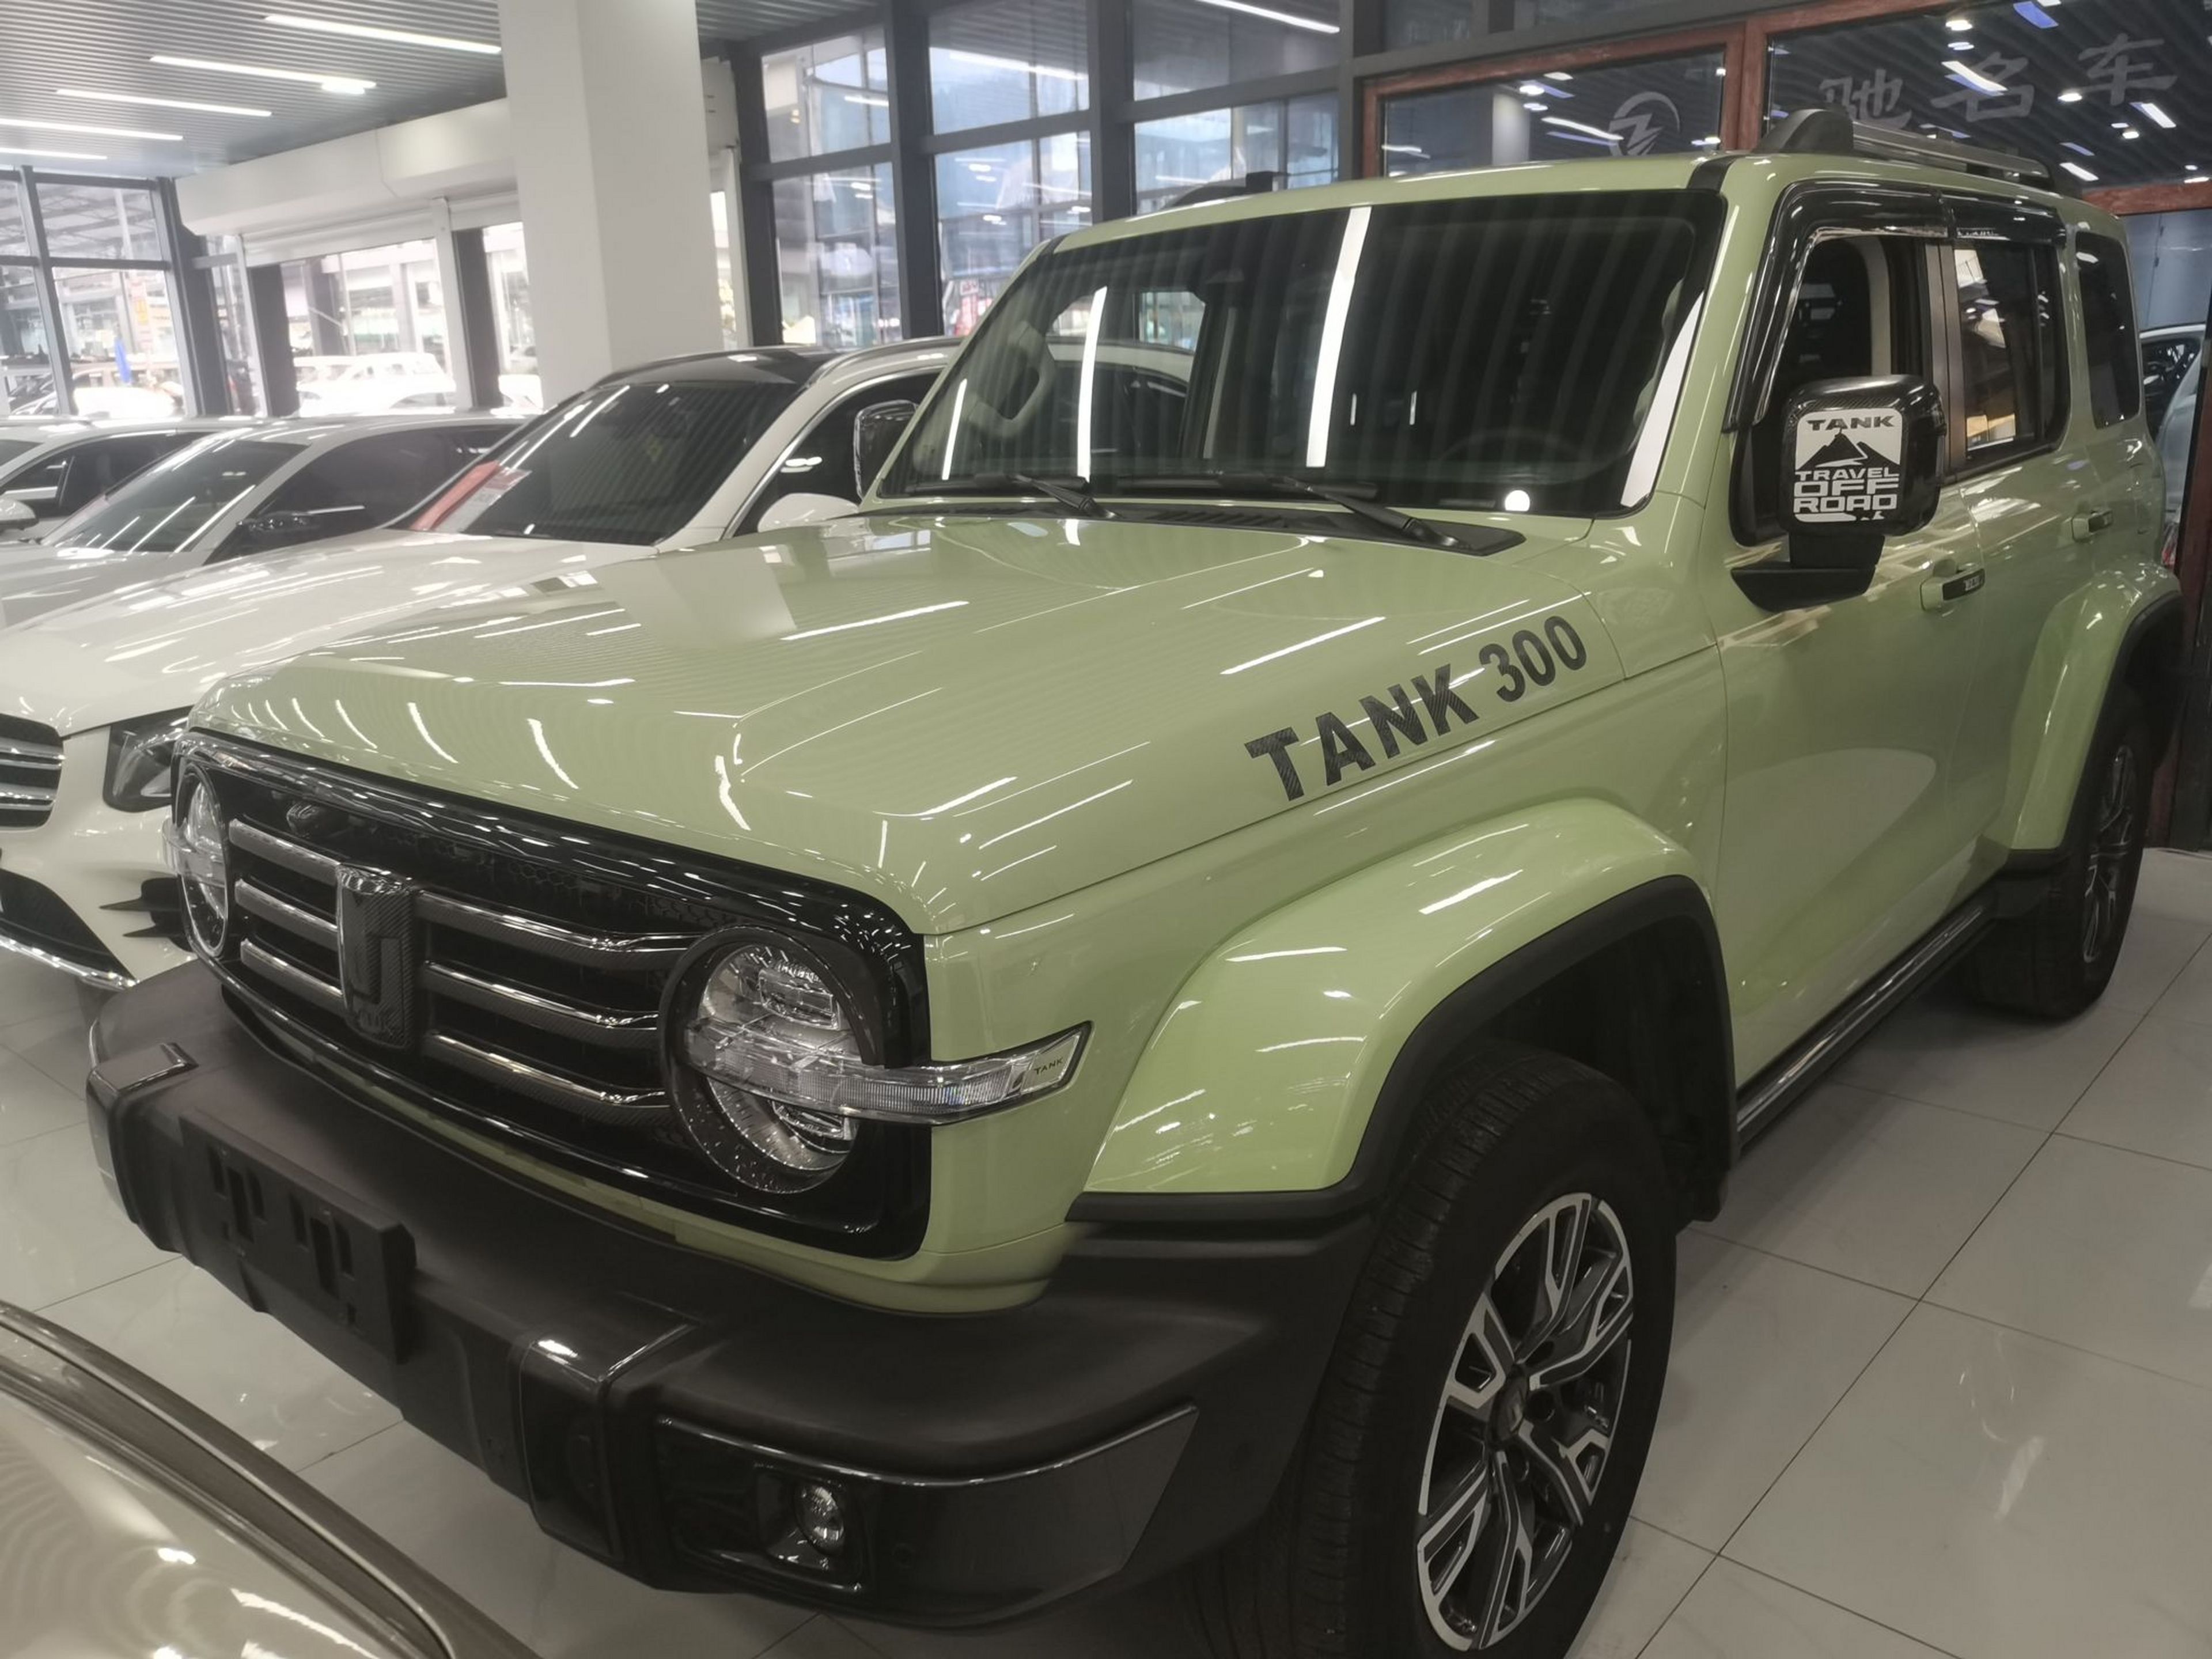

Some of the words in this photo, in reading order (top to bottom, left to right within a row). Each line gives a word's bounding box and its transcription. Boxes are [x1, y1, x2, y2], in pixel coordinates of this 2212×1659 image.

[1806, 415, 1895, 431] TANK
[1795, 467, 1900, 481] TRAVEL
[1794, 478, 1899, 498] OFF
[1793, 494, 1897, 513] ROAD
[1244, 664, 1480, 801] TANK
[1479, 615, 1588, 703] 300
[1034, 1058, 1063, 1075] TANK
